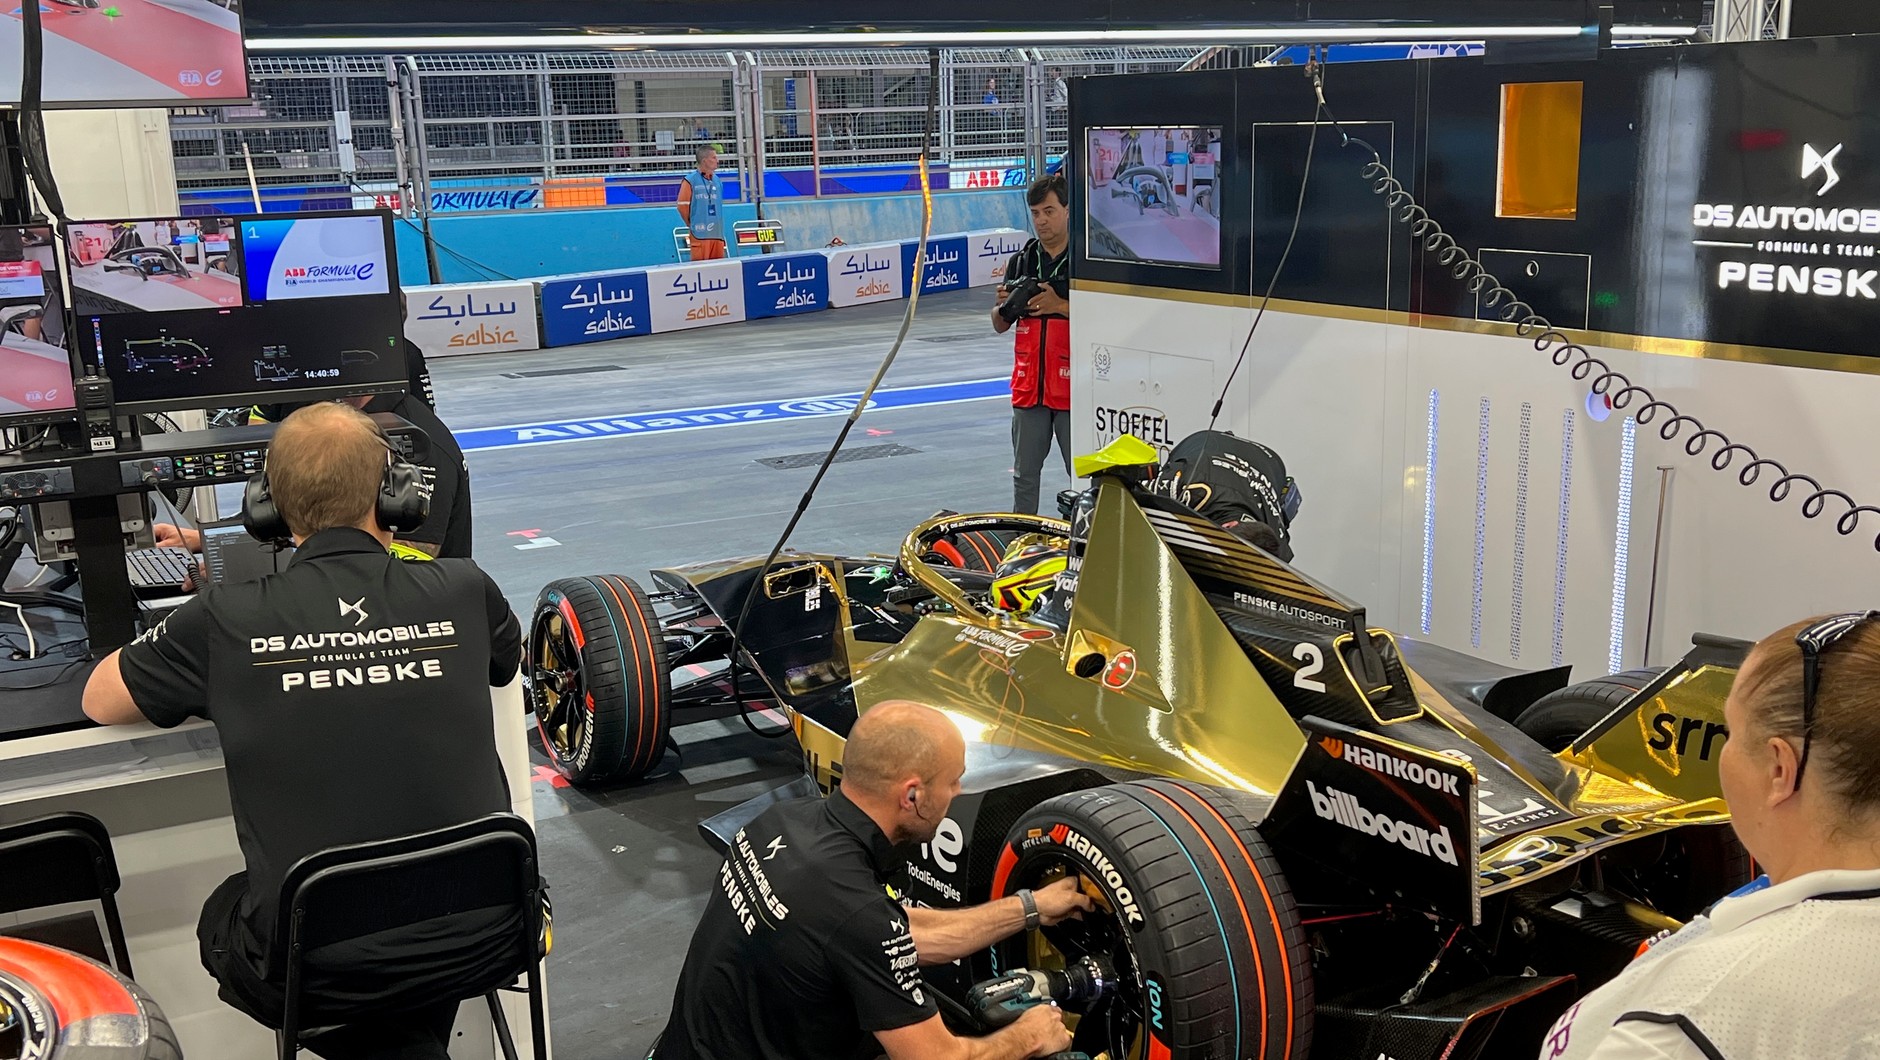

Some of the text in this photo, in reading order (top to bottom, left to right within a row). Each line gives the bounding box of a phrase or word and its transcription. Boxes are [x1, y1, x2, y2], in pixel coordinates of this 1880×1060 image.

[966, 169, 1001, 188] ABB
[1693, 204, 1735, 228] DS
[757, 229, 775, 242] GUE
[1757, 241, 1874, 257] FORMULA E TEAM
[285, 268, 306, 278] ABB
[306, 263, 356, 278] FORMULA
[757, 261, 816, 290] سابك
[840, 252, 890, 279] سابك
[926, 267, 959, 288] sabic
[562, 282, 634, 314] سابك
[665, 272, 729, 301] سابك
[775, 286, 817, 309] sabic
[856, 277, 892, 297] sabic
[416, 293, 516, 326] سابك
[584, 310, 636, 335] sabic
[685, 298, 731, 321] sabic
[447, 322, 519, 348] sabic
[304, 368, 340, 380] 14:40:59
[511, 407, 780, 441] Allianz
[1095, 406, 1174, 446] STOFFEL
[1233, 591, 1347, 629] PENSKE AUTOSPORT
[250, 620, 456, 654] DS AUTOMOBILES
[312, 647, 410, 663] FORMULA E TEAM
[1292, 642, 1326, 694] 2
[282, 658, 443, 692] PENSKE
[1305, 779, 1459, 867] billboard
[738, 840, 789, 920] AUTOMOBILES
[906, 860, 961, 903] TotalEnergies
[720, 859, 757, 936] PENSKE
